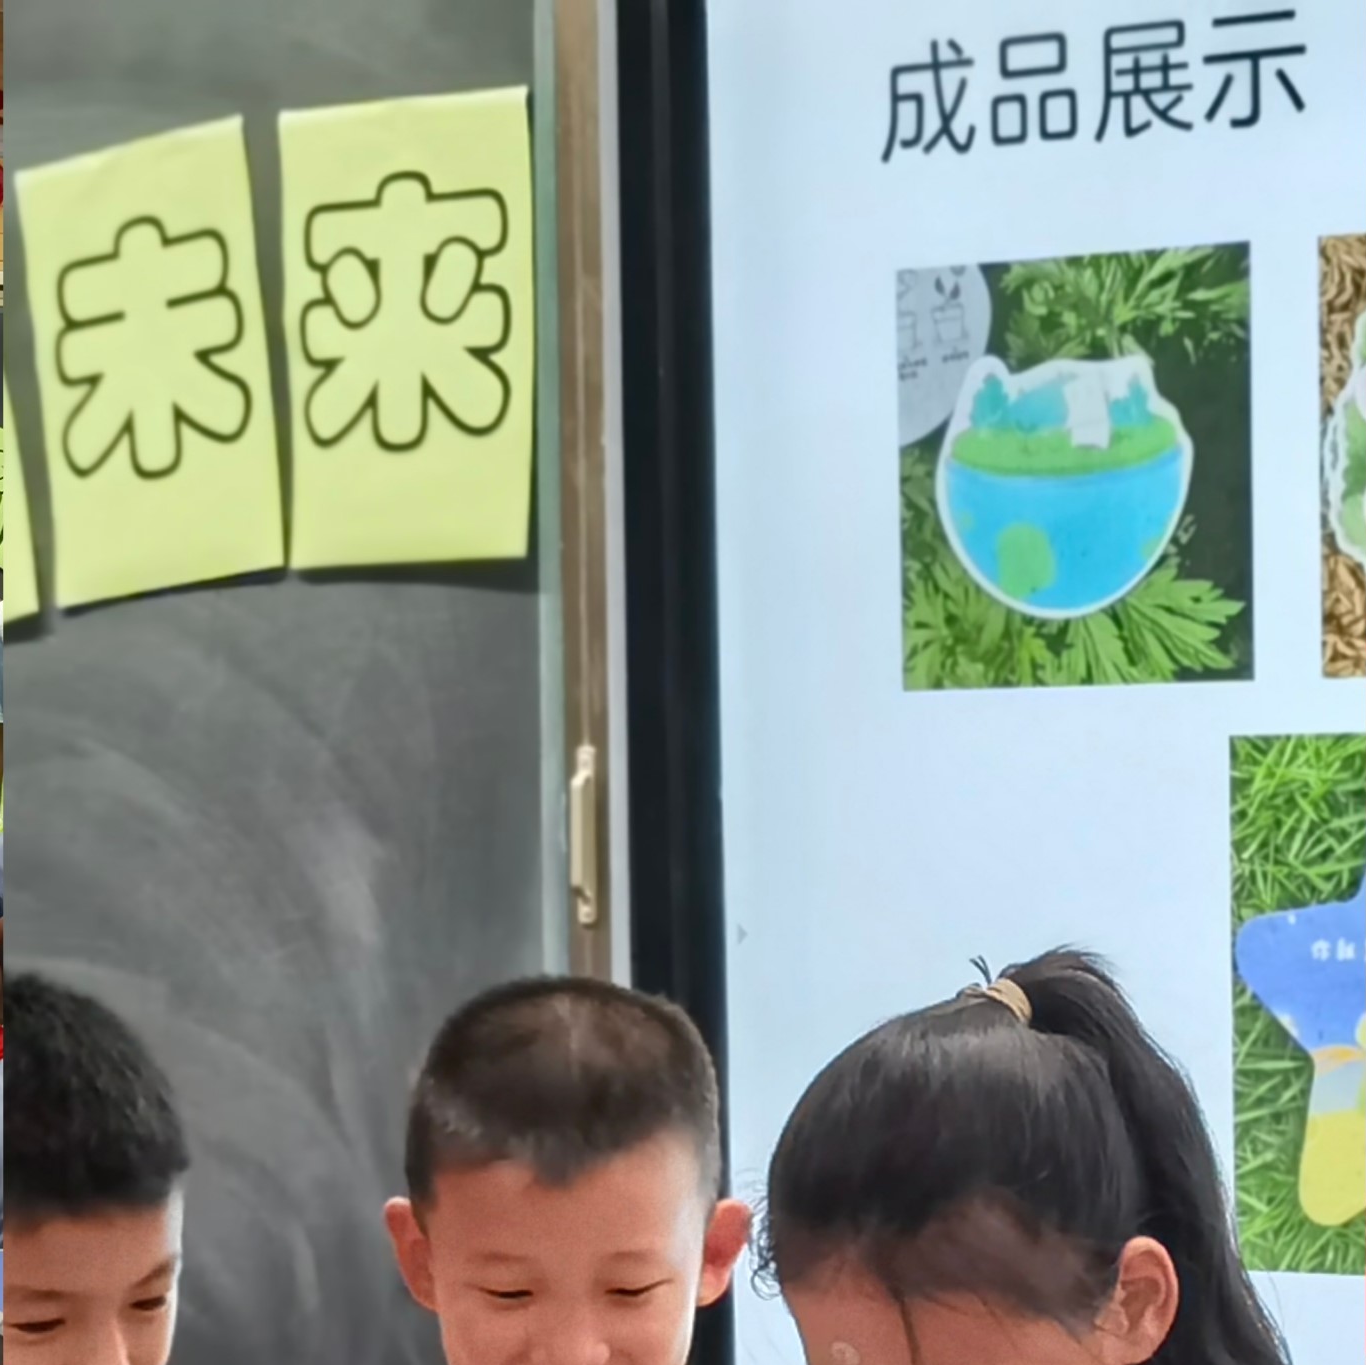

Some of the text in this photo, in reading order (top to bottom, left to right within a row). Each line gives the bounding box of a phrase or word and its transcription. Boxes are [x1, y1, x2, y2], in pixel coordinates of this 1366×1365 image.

[881, 9, 1307, 163] 成品展示
[55, 171, 513, 480] 未来
